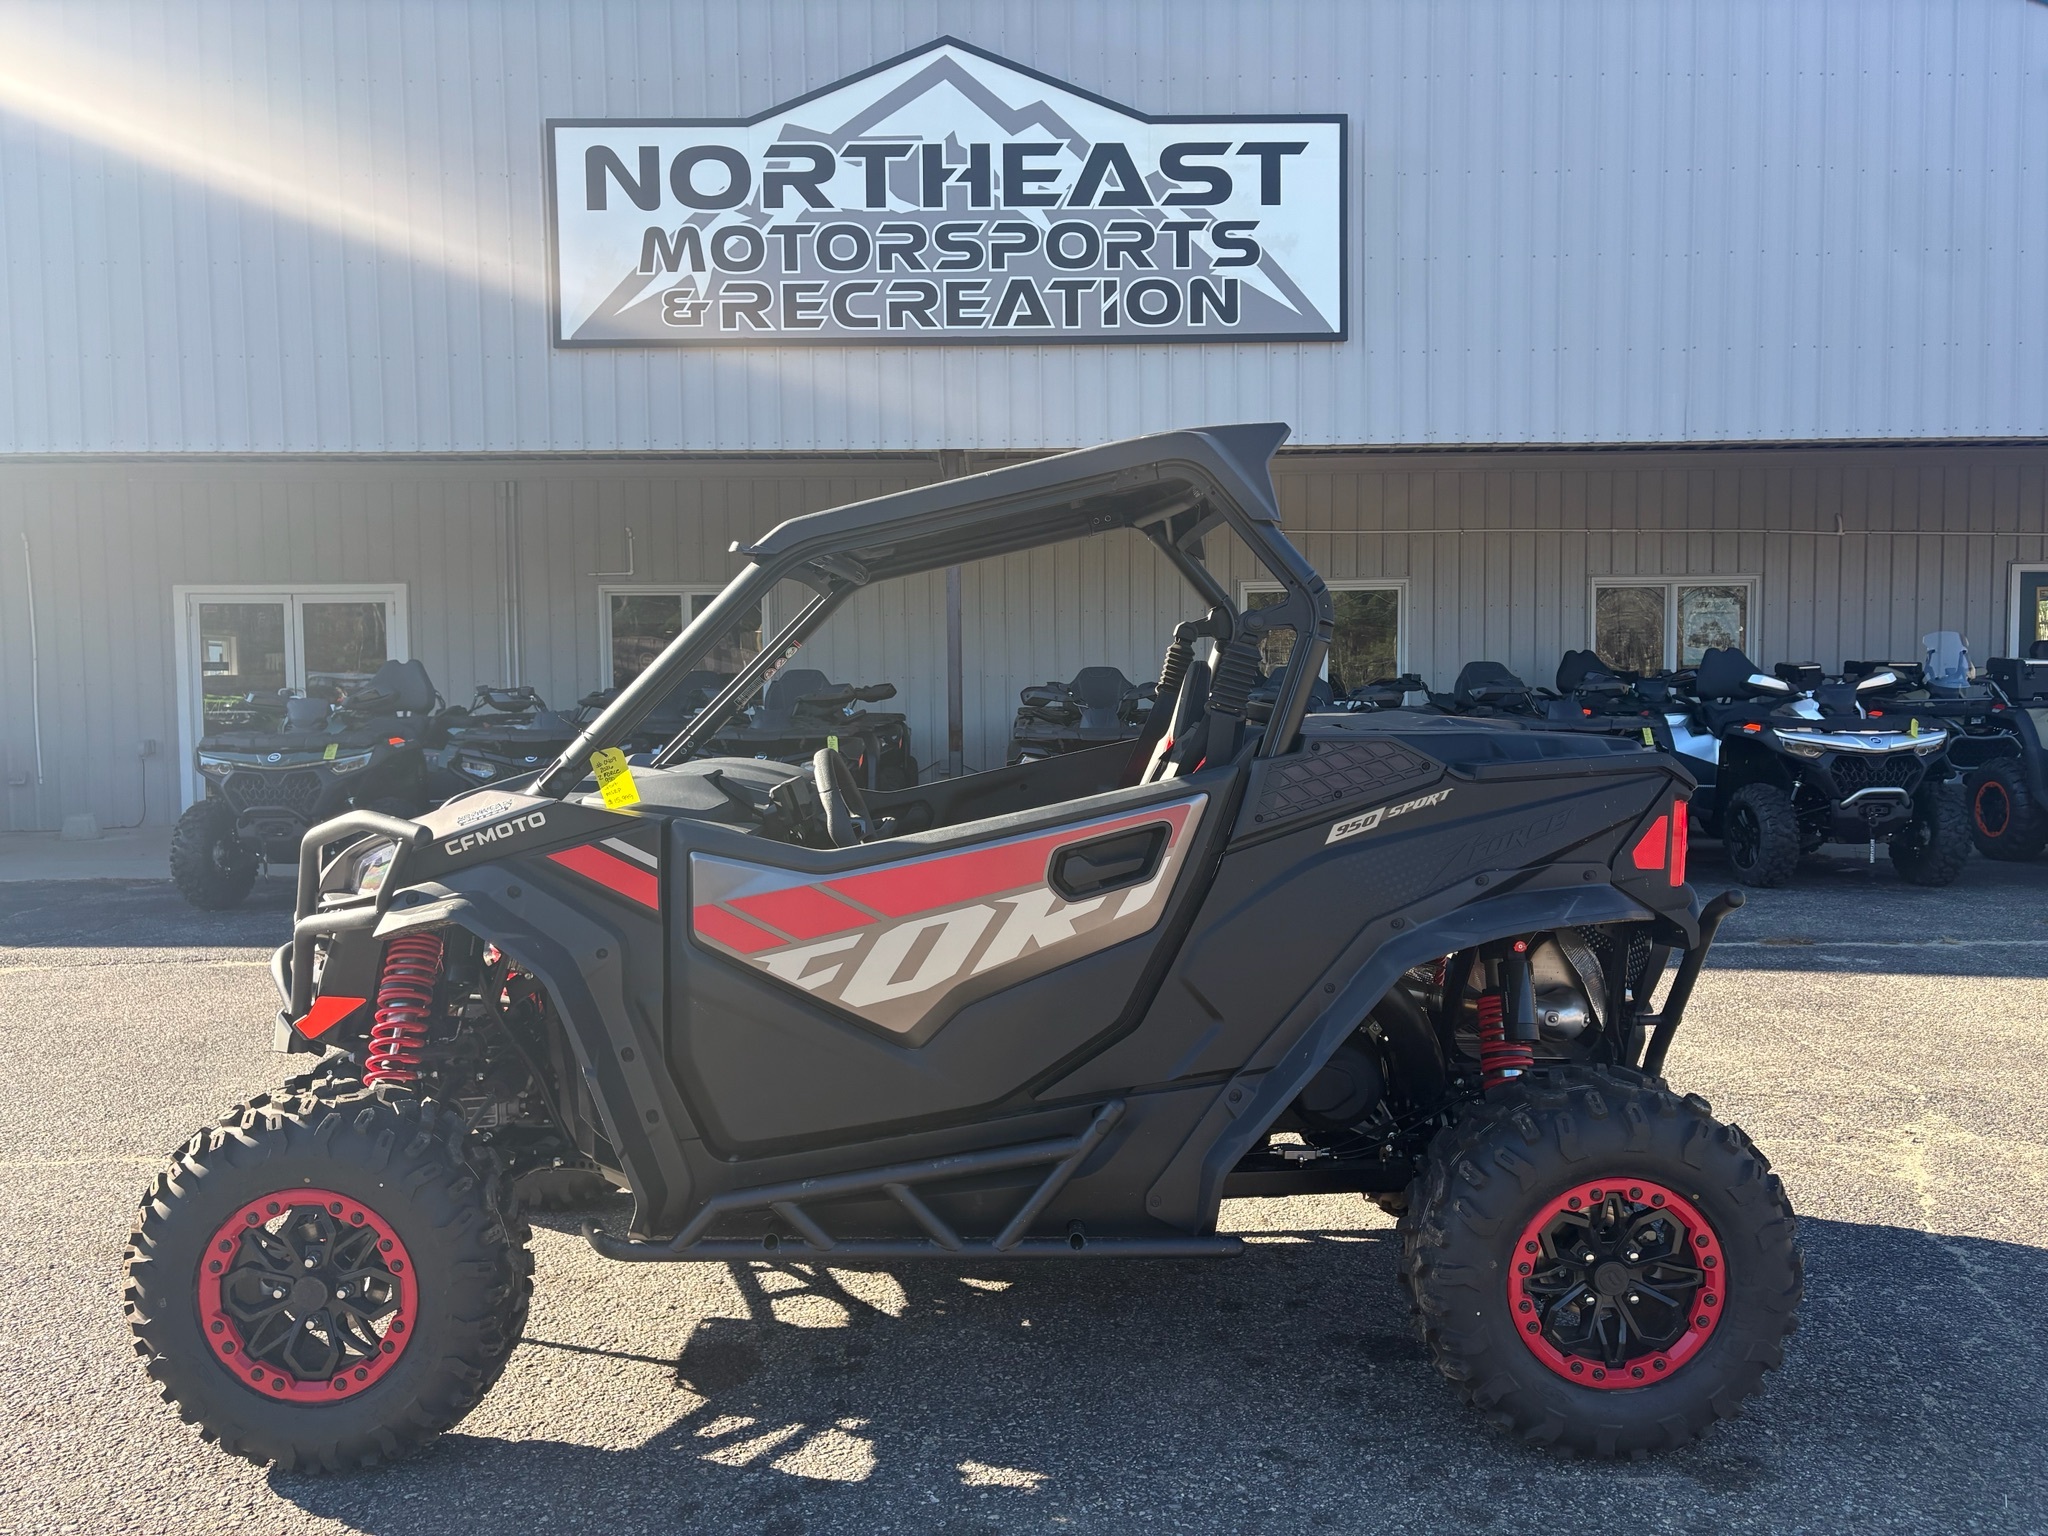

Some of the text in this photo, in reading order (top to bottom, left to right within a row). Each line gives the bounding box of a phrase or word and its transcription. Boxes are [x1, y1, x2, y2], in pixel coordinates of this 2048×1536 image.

[585, 141, 1310, 212] NORTHEAST
[637, 220, 1262, 275] MOTORSPORTS
[444, 811, 547, 856] CFMOTO
[1335, 787, 1454, 837] 950 SPORT
